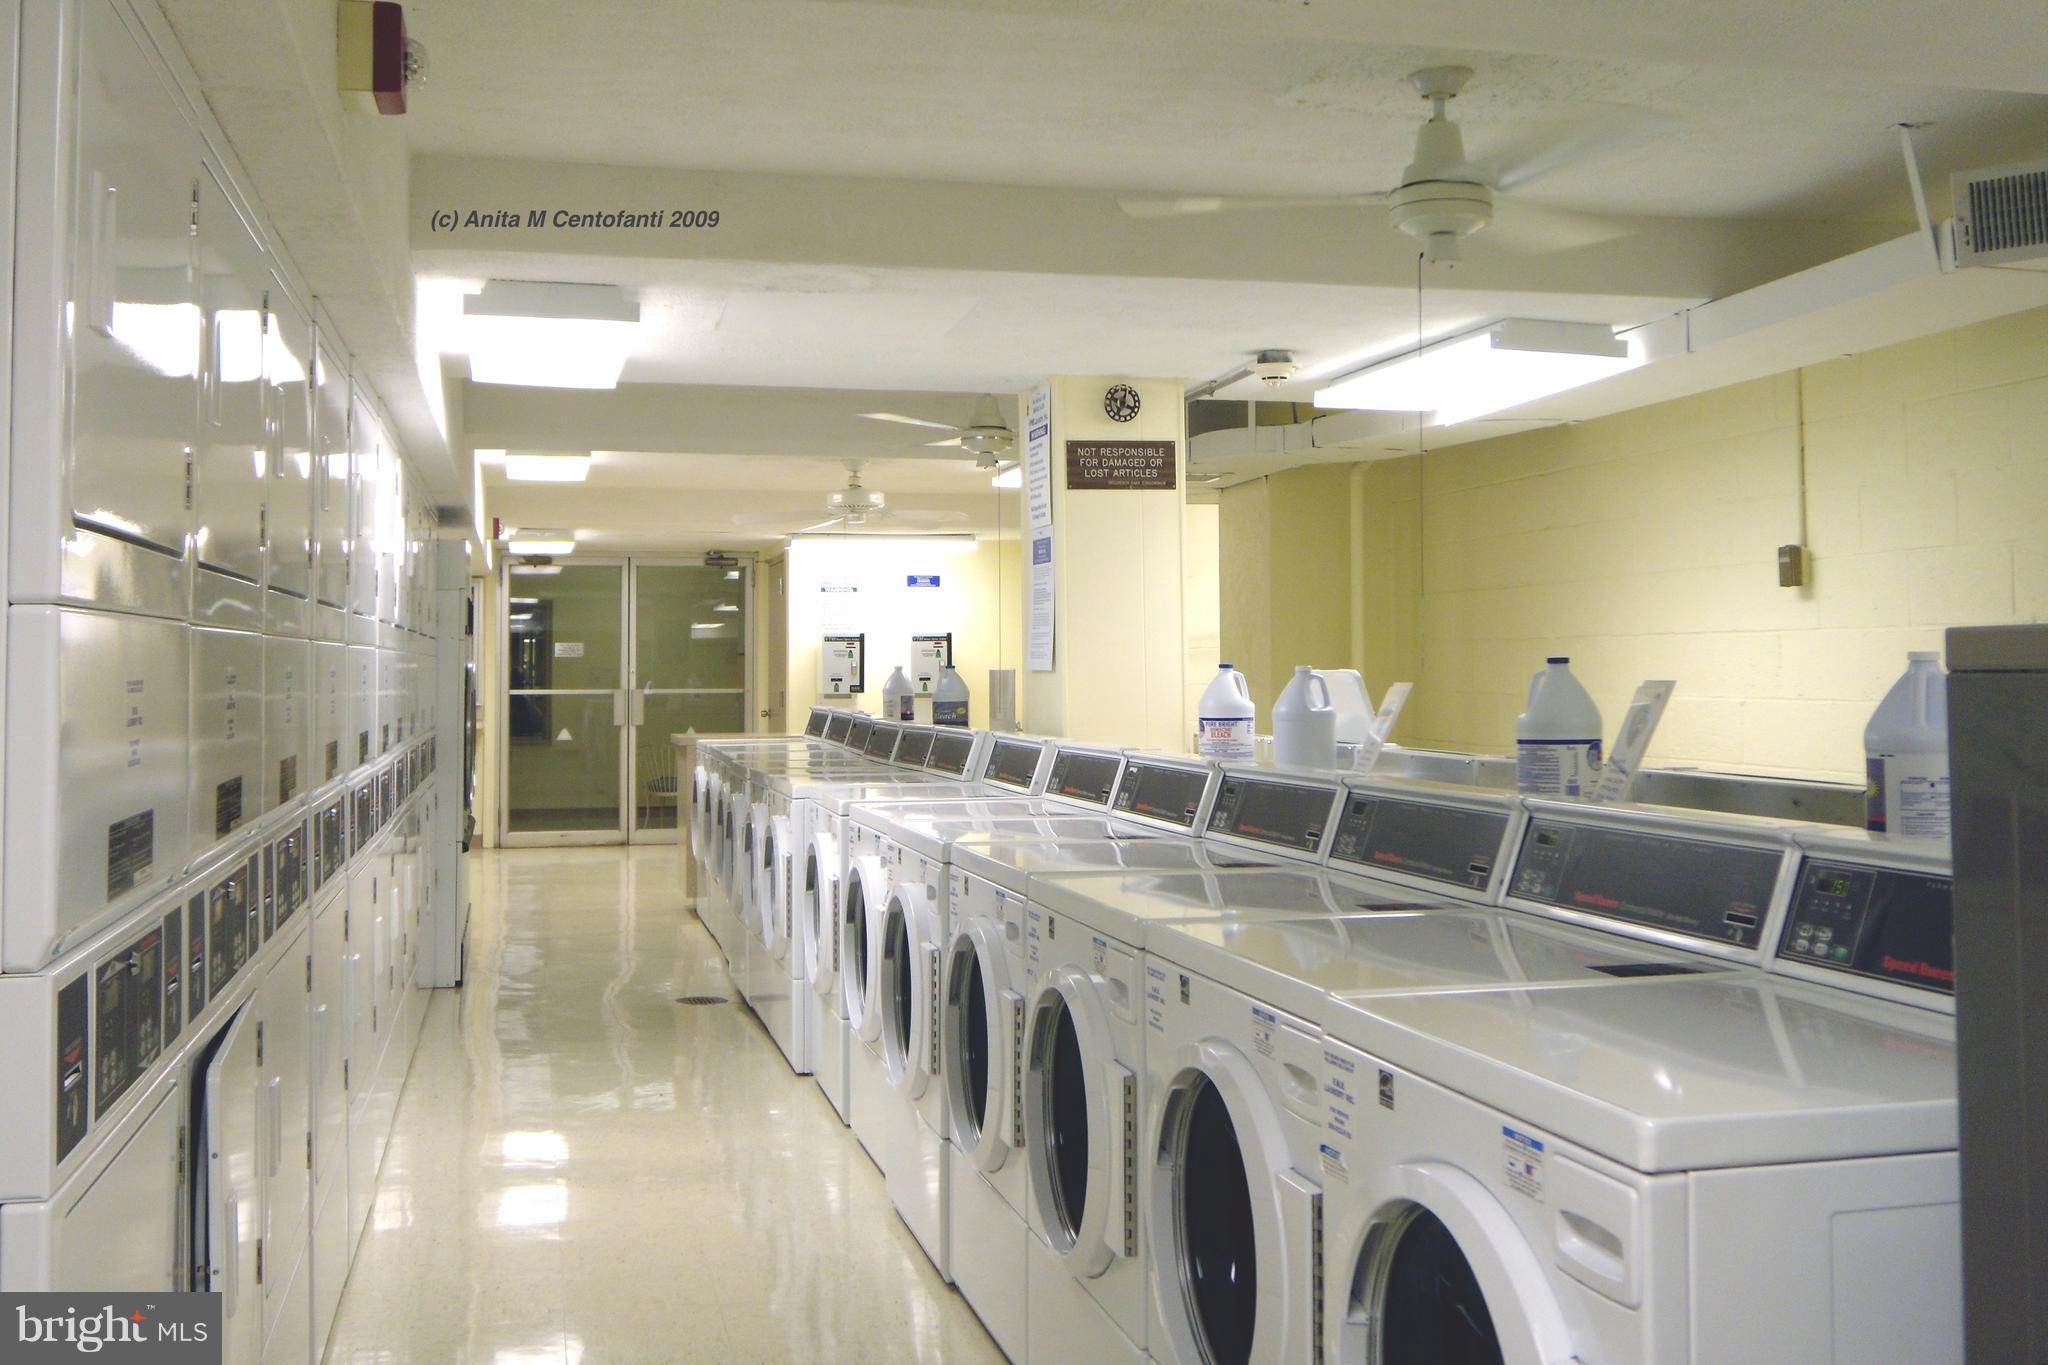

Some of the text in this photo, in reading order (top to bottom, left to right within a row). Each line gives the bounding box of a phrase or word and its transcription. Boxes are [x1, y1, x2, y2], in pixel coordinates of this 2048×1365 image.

[1077, 447, 1165, 456] NOT RESPONSIBLE
[1080, 458, 1163, 467] FOR DAMAGED OR
[1084, 468, 1158, 478] LOST ARTICLES
